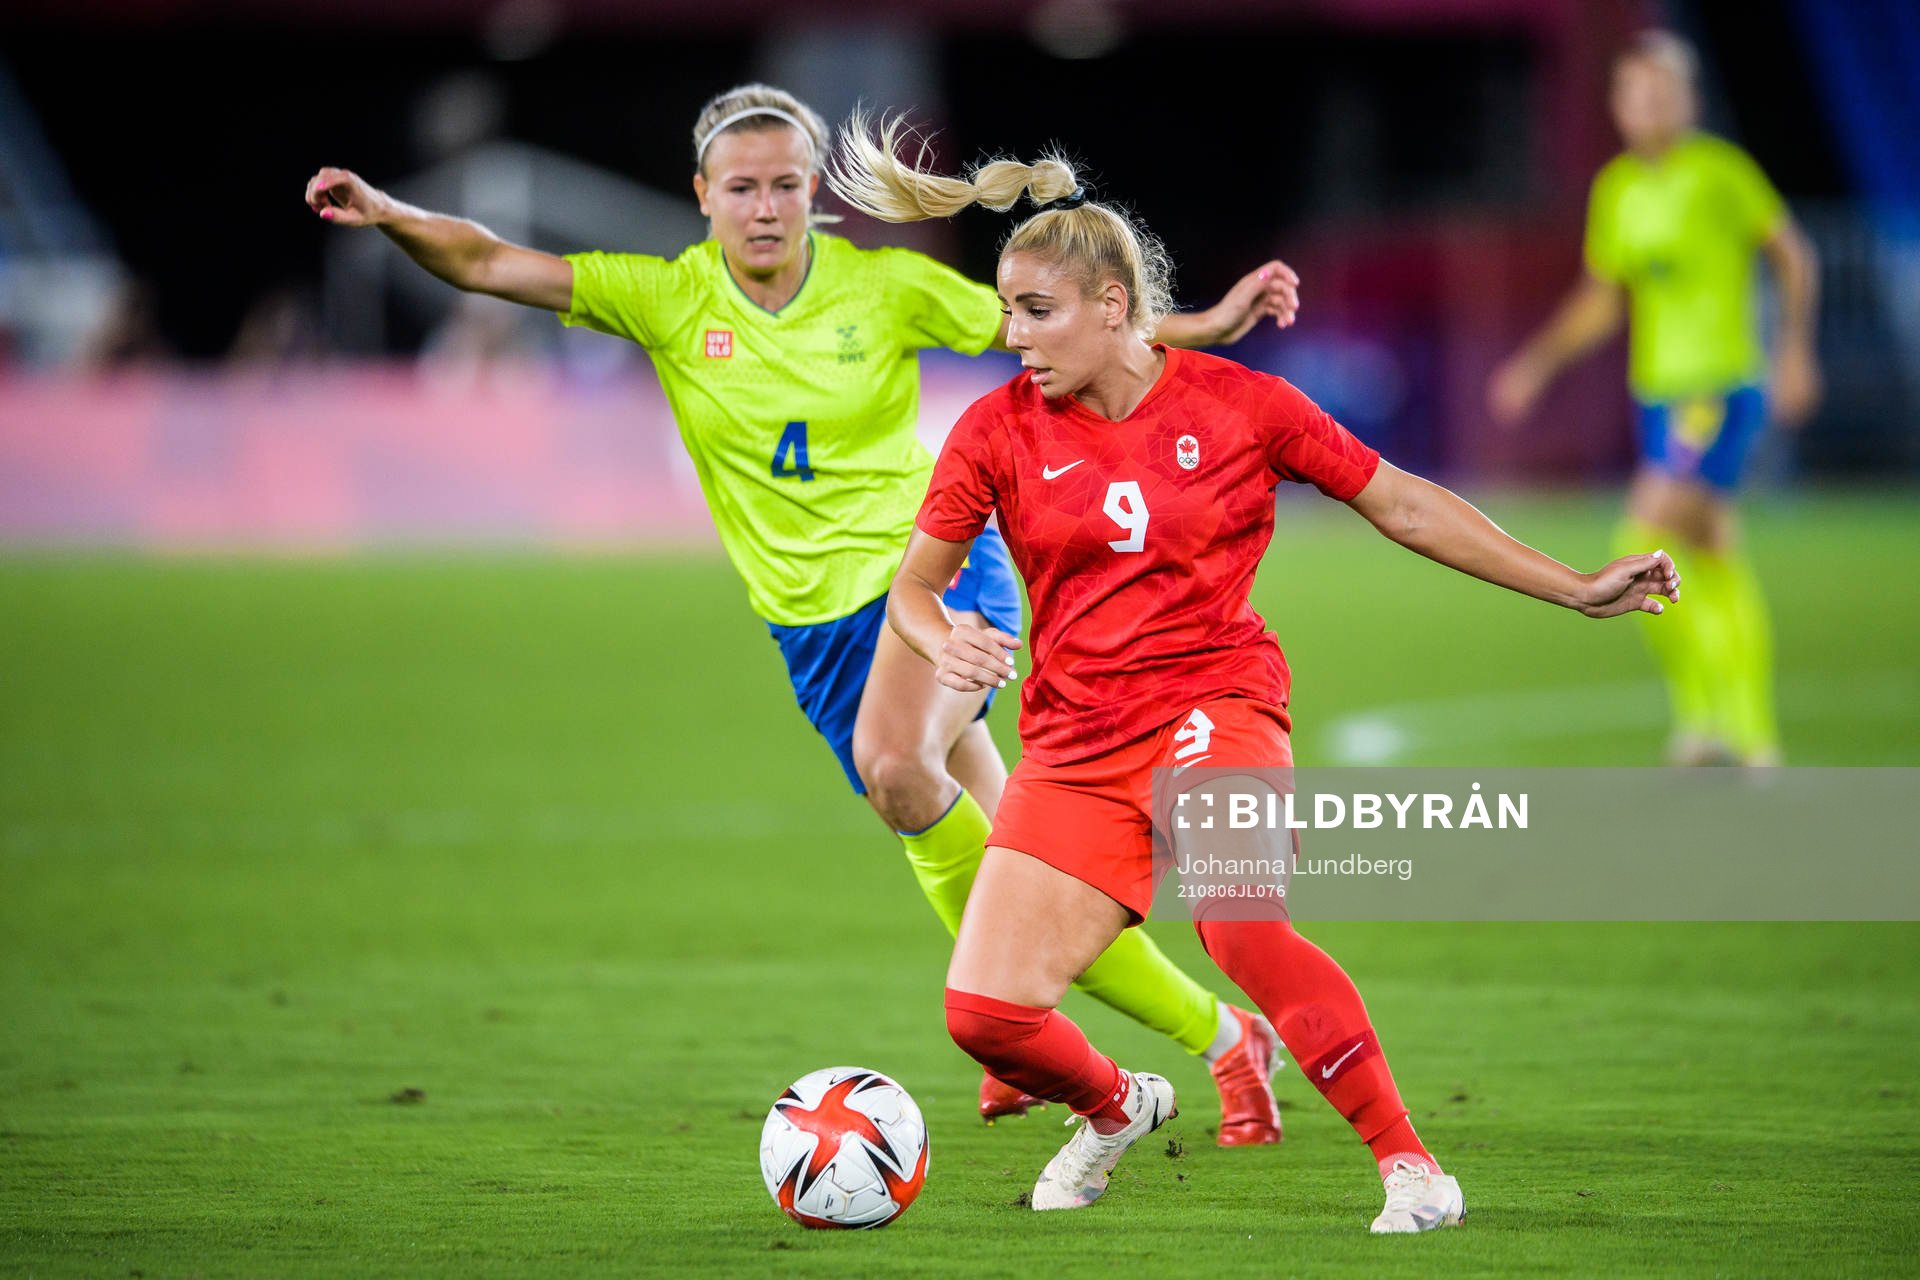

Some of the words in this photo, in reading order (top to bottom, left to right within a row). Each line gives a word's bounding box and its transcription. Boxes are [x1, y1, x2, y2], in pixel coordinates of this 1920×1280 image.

[771, 421, 815, 482] 4
[1102, 480, 1150, 552] 9
[1174, 708, 1215, 760] 9
